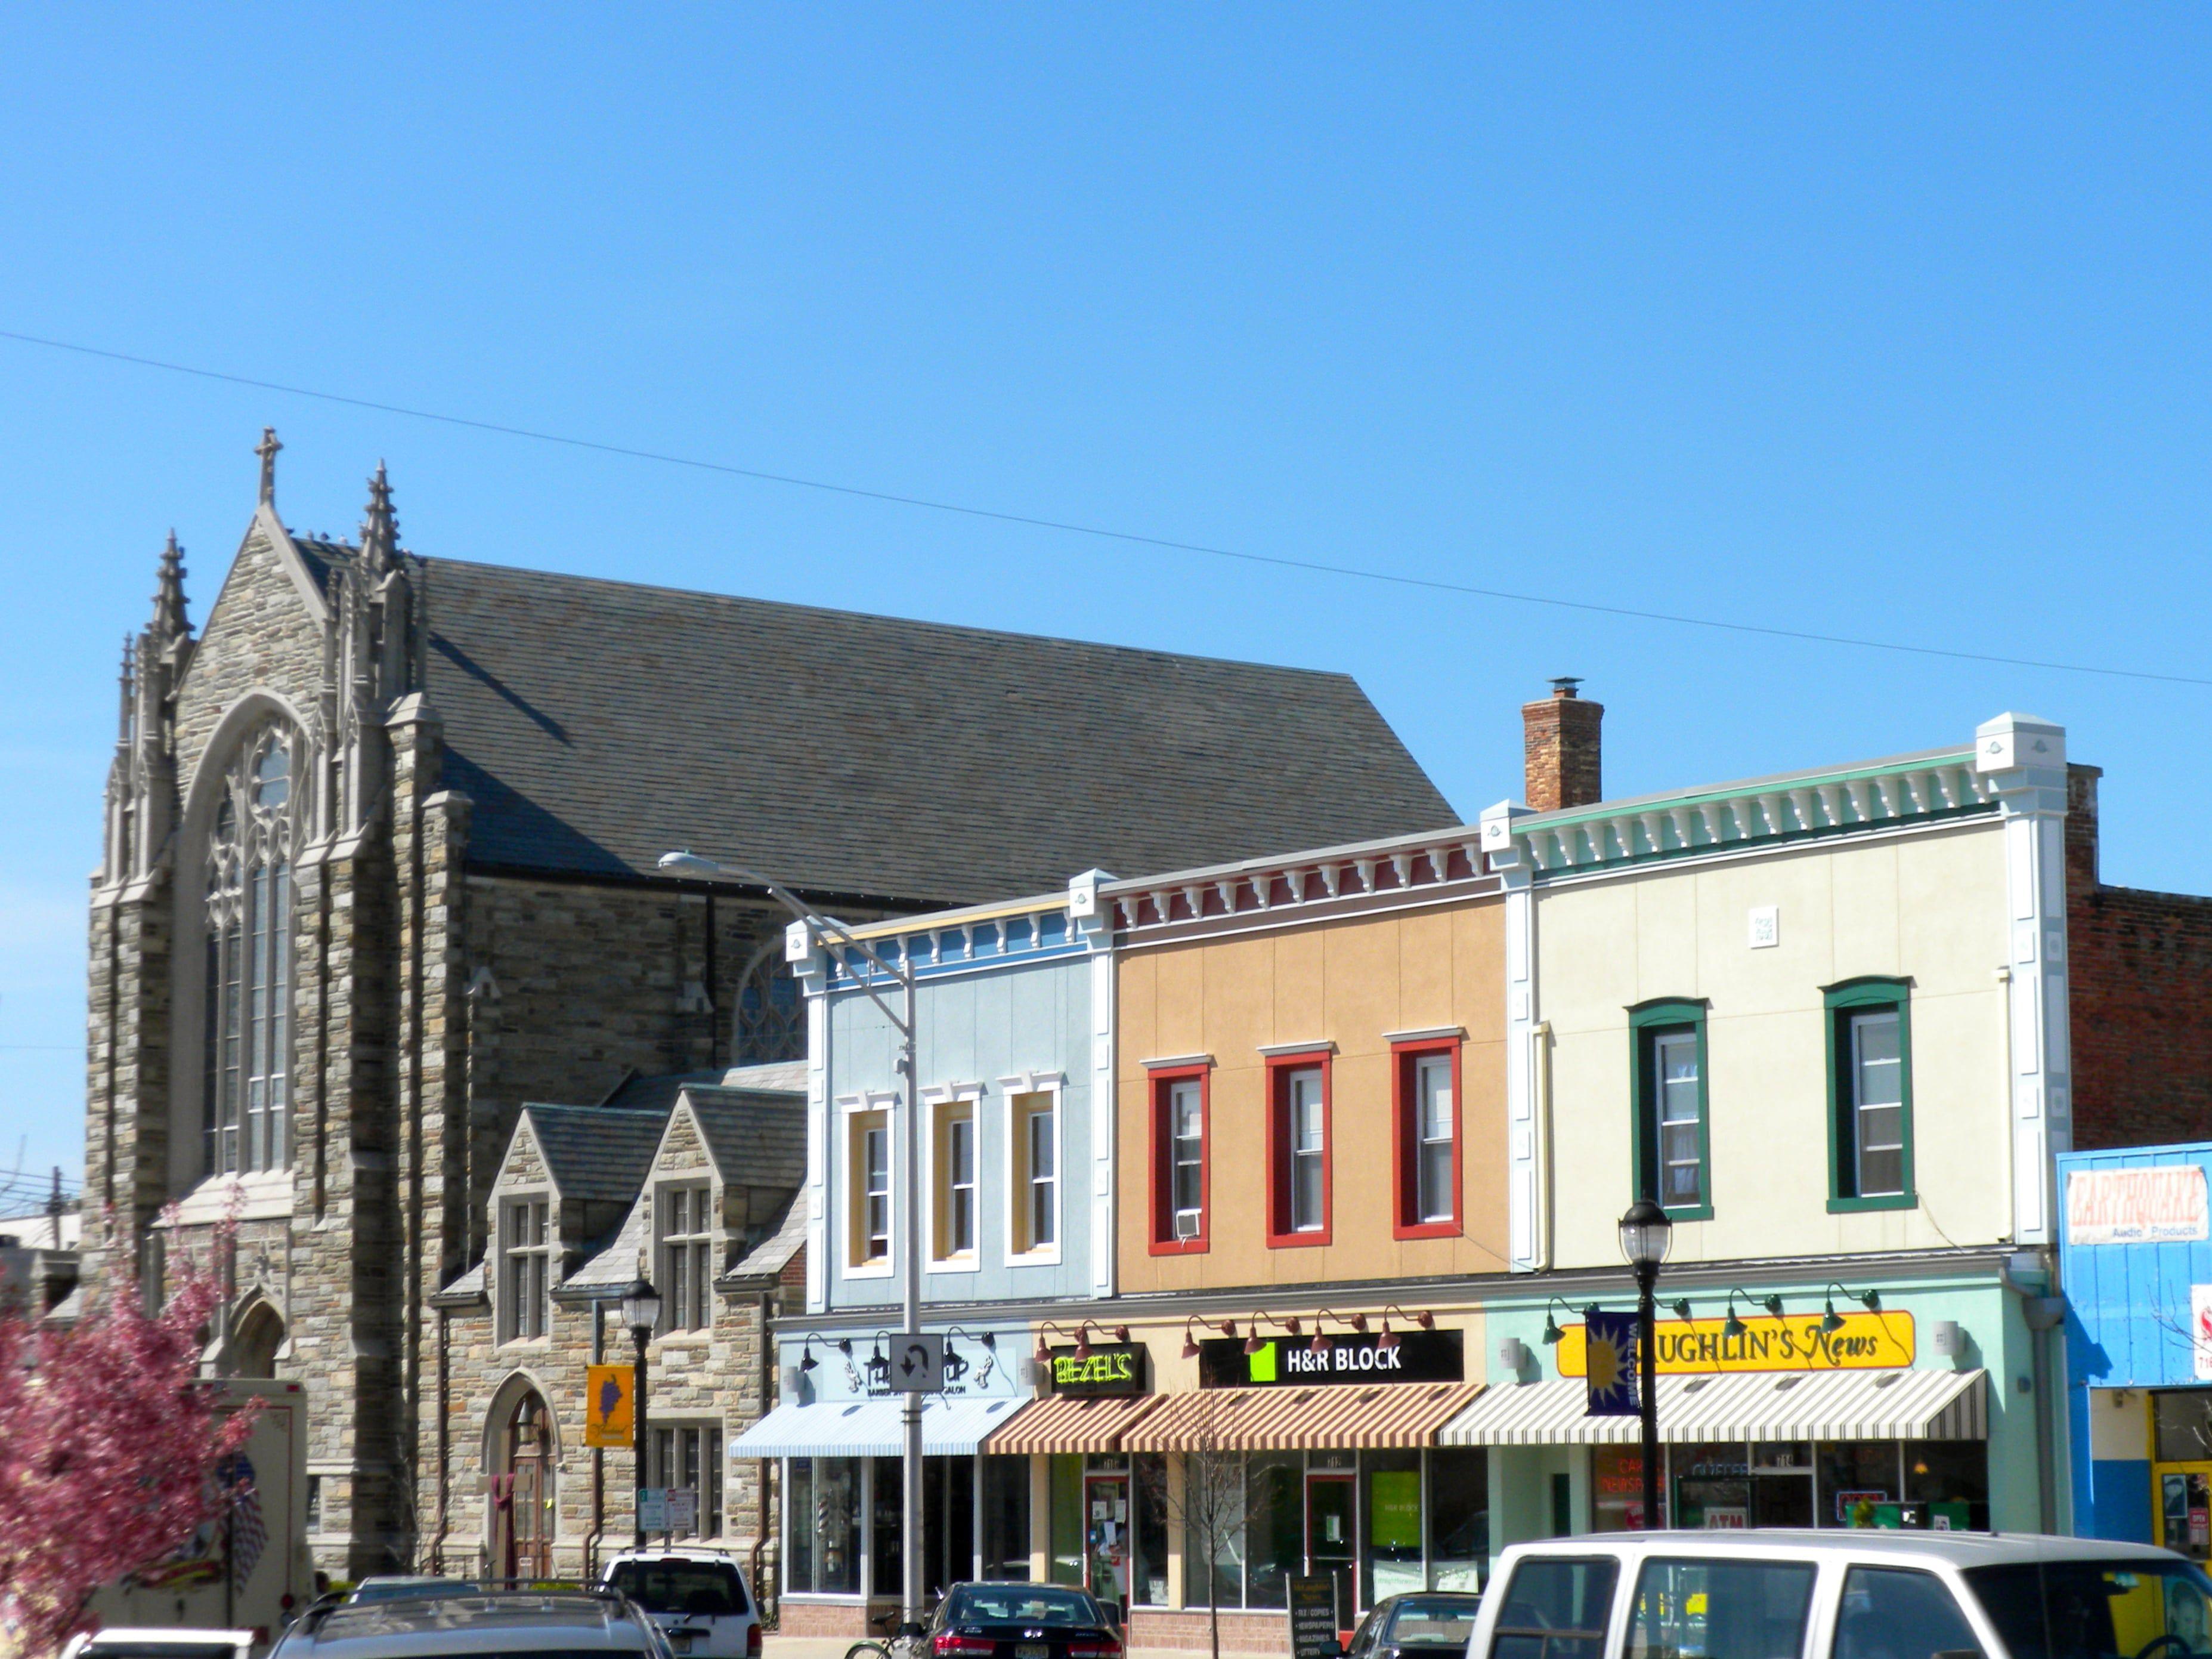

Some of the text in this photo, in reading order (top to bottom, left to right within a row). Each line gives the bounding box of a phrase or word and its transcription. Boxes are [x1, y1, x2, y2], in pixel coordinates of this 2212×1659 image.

[2112, 1226, 2198, 1238] Audio Products
[1287, 1345, 1402, 1373] H&R BLOCK
[1805, 1326, 1878, 1367] News
[1054, 1352, 1132, 1383] BEZEL'S
[1627, 1322, 1639, 1406] WELCOME
[943, 1386, 966, 1395] SALON
[1709, 1514, 1744, 1529] ATM
